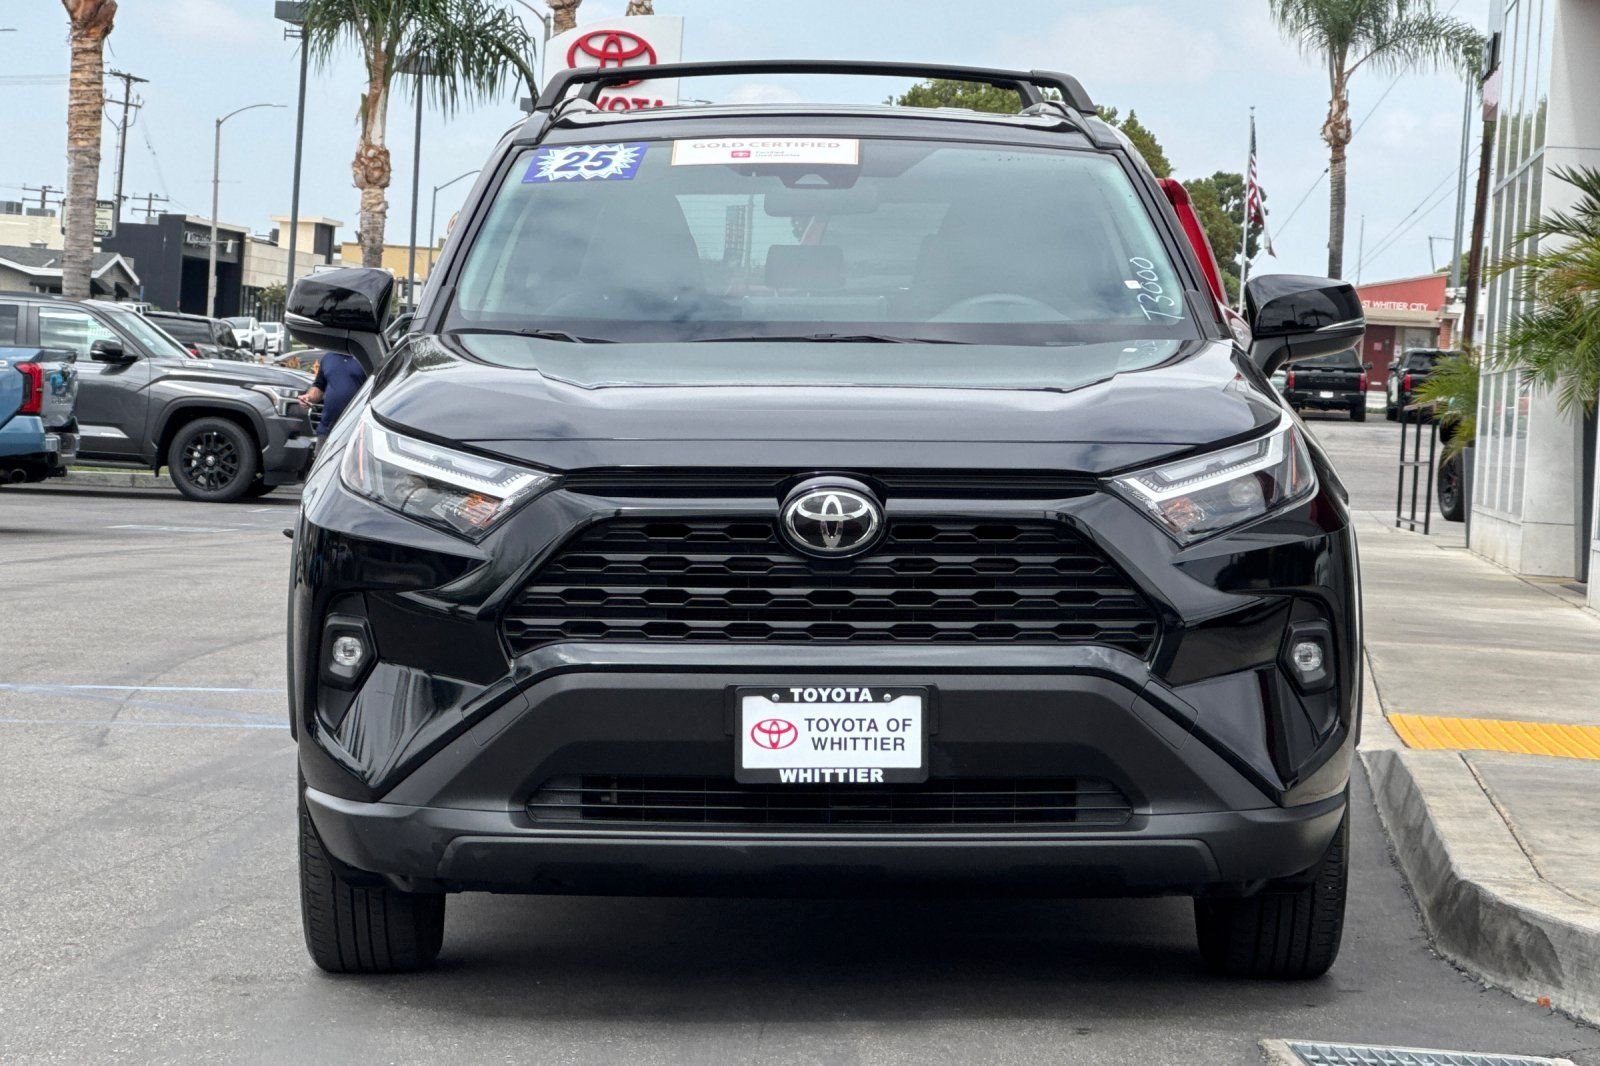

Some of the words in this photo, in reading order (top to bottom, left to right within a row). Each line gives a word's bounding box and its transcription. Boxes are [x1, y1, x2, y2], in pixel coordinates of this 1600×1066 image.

[749, 141, 841, 149] CERTIFIED
[554, 151, 619, 172] 25
[1372, 301, 1408, 311] WHITTIER
[1409, 302, 1429, 312] CITY
[790, 687, 873, 702] TOYOTA
[804, 718, 879, 732] TOYOTA
[886, 718, 913, 732] OF
[811, 737, 905, 751] WHITTIER
[779, 768, 884, 783] WHITTIER
